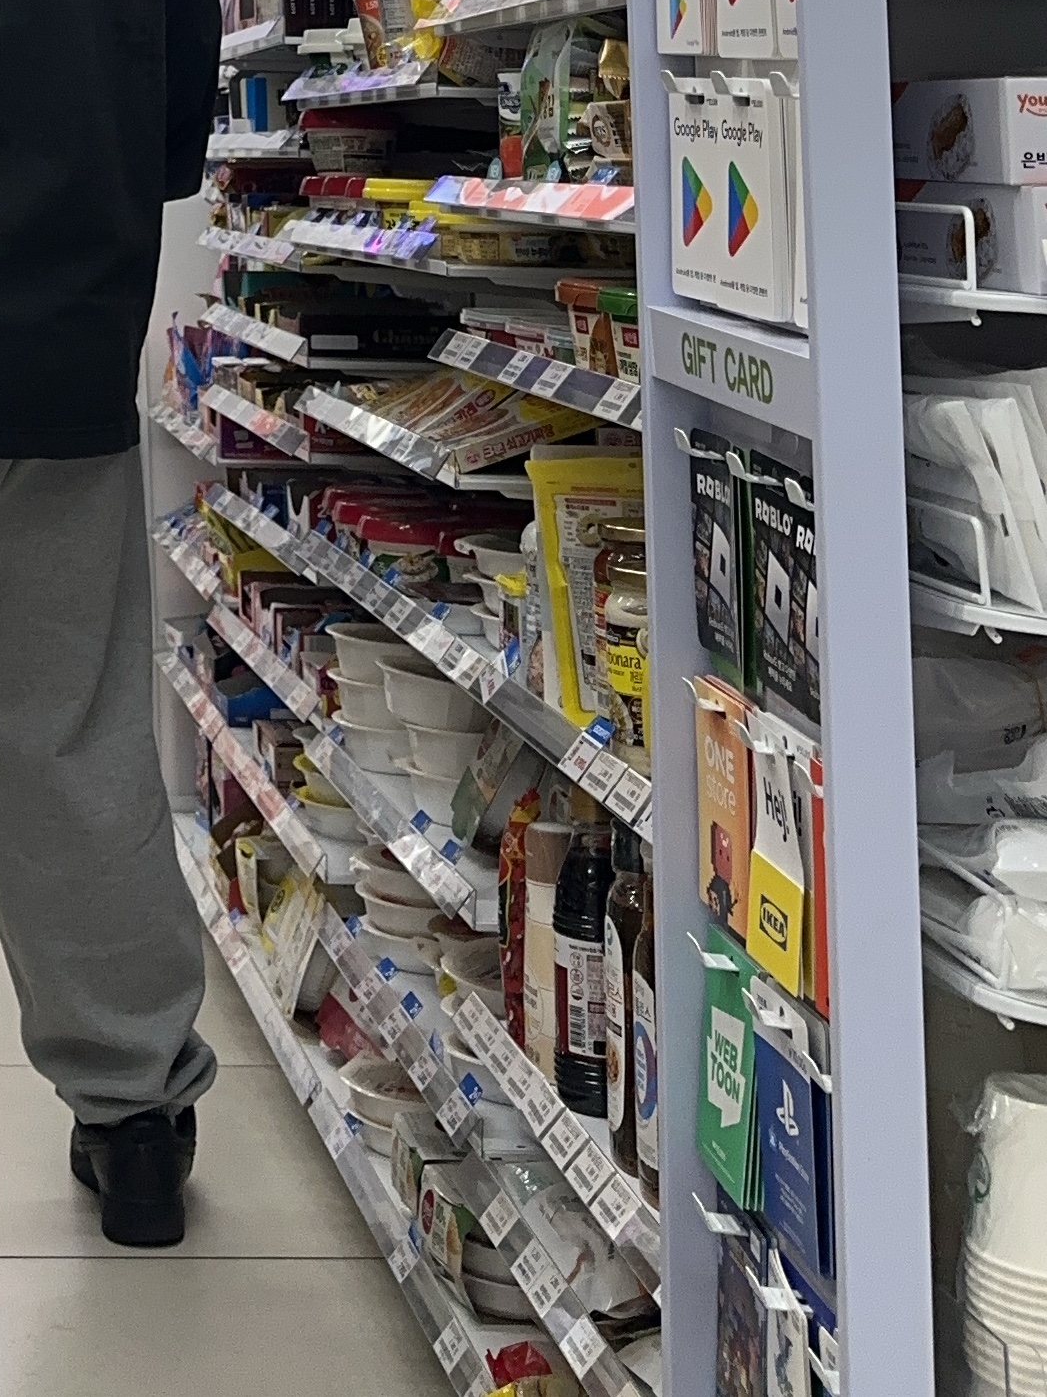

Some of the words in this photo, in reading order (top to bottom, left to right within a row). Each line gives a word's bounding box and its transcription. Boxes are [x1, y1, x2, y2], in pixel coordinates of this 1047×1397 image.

[674, 117, 701, 144] Google
[702, 118, 719, 144] Play
[721, 119, 747, 146] Google
[748, 121, 763, 148] Play
[681, 331, 717, 383] GIFT
[724, 347, 774, 404] CARD
[696, 473, 730, 506] ROBLO
[755, 497, 794, 537] ROBLO
[705, 734, 736, 785] ONE
[706, 773, 737, 816] store
[763, 776, 790, 843] Hej!
[762, 905, 786, 939] IKEA
[714, 1028, 739, 1073] WEB
[710, 1052, 741, 1105] TOON
